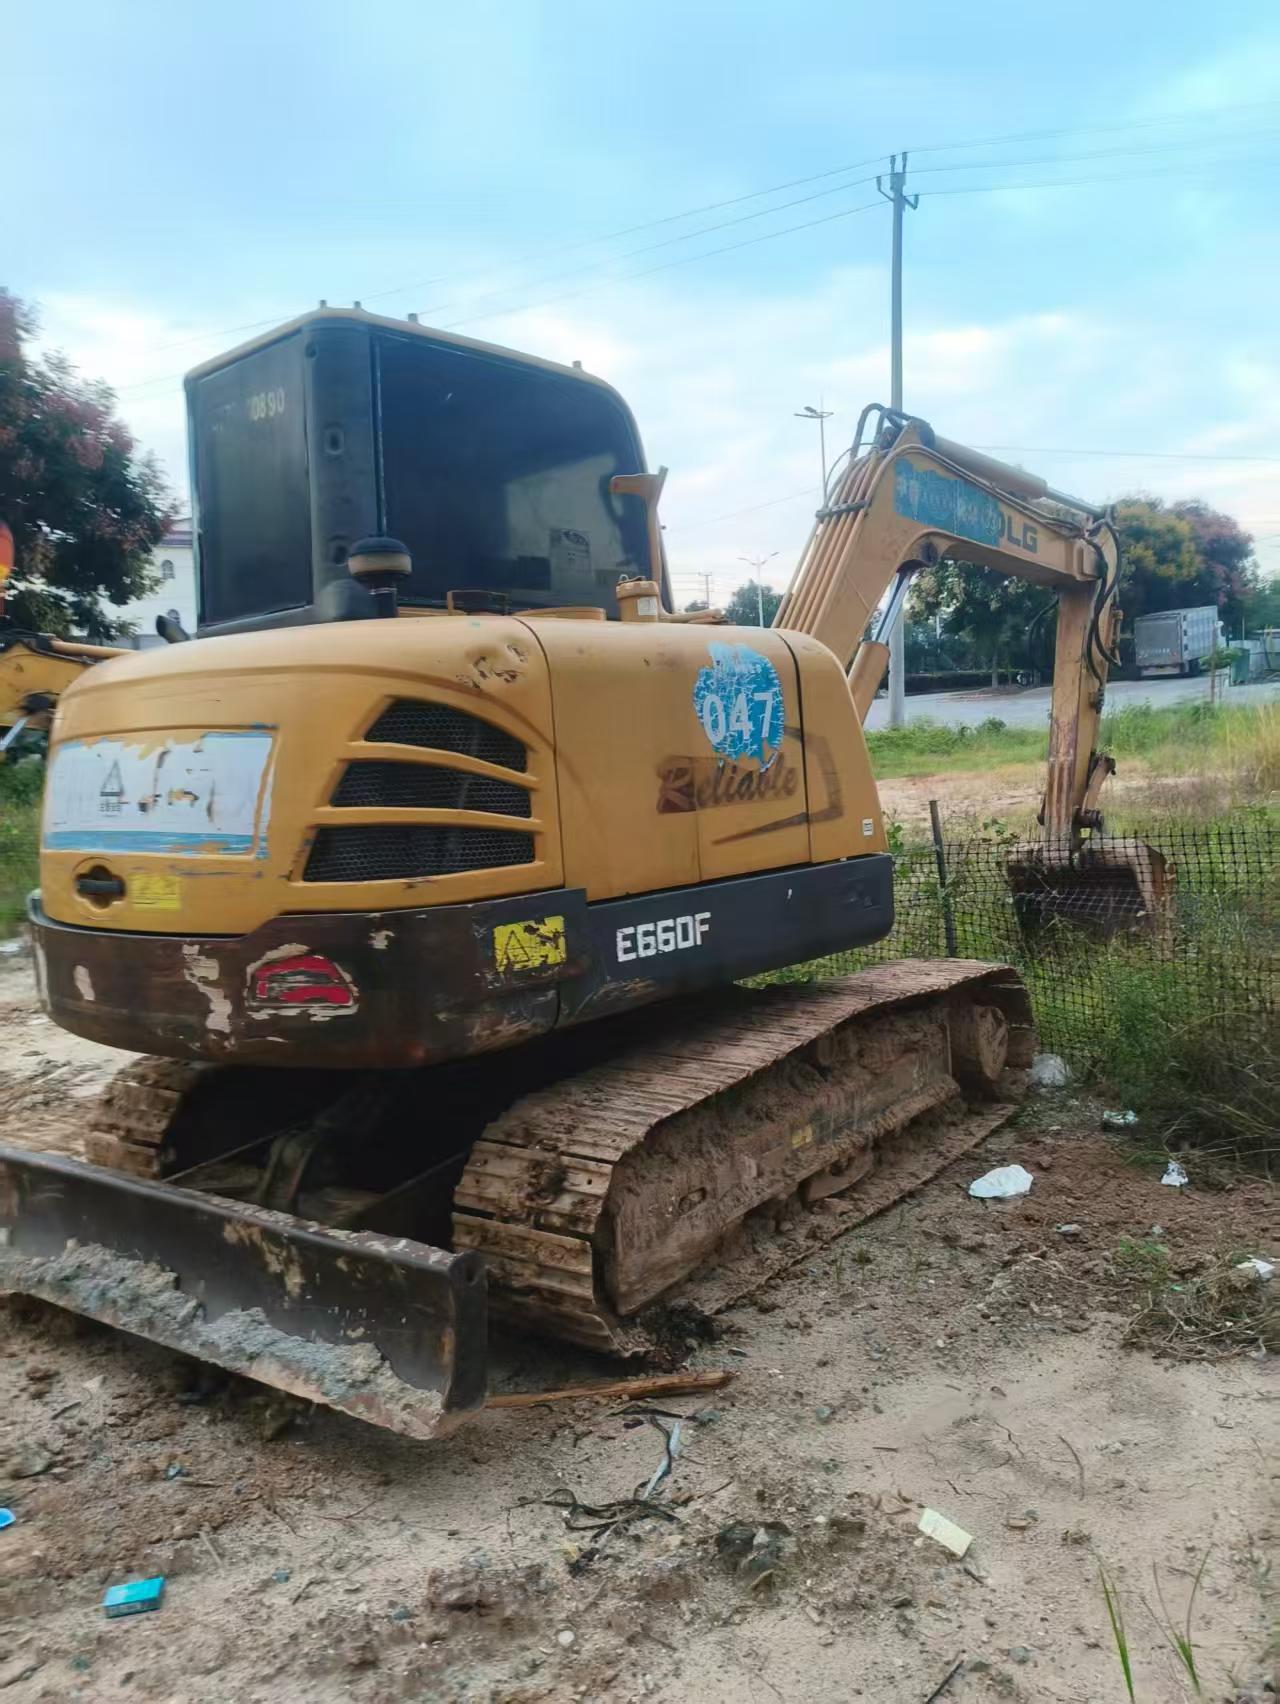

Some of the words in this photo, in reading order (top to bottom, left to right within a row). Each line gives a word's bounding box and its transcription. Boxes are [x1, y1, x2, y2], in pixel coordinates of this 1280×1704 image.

[1001, 512, 1038, 553] LG
[703, 690, 773, 745] 047
[657, 754, 798, 813] Reliable
[616, 912, 712, 962] E660F
